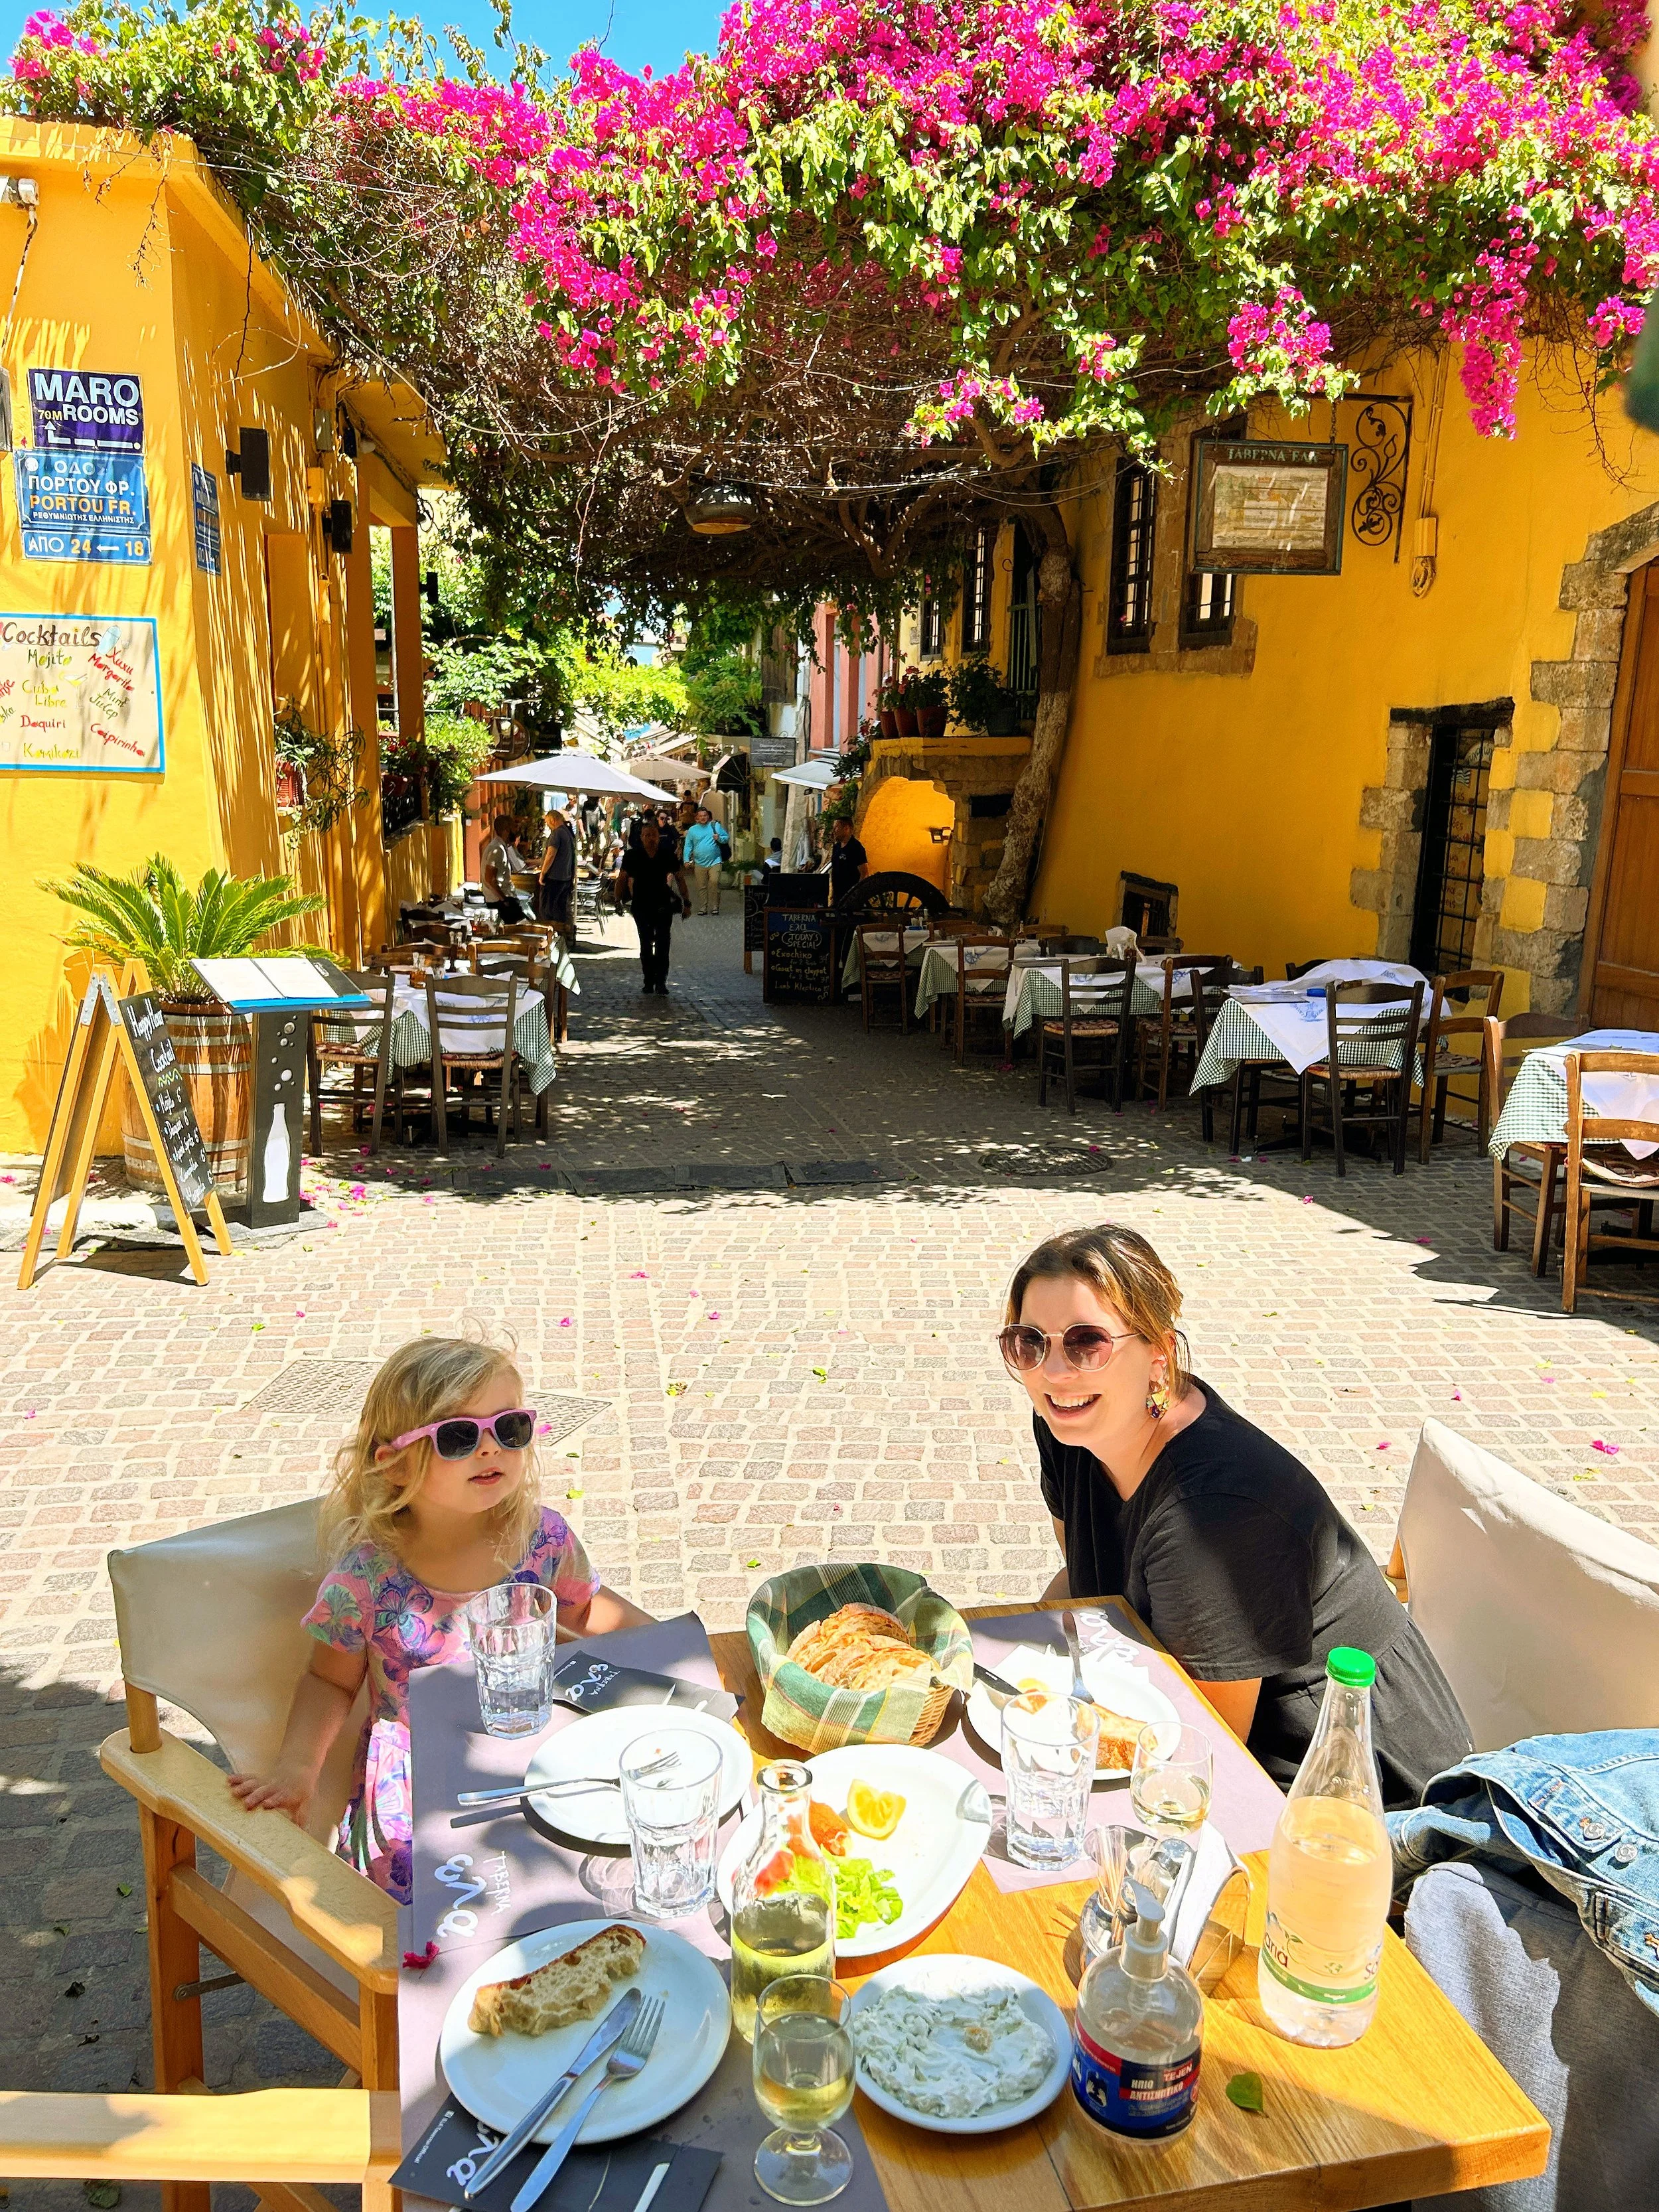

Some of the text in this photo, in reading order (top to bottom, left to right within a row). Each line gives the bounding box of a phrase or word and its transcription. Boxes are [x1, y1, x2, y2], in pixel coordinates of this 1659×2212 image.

[34, 373, 139, 407] MARO
[62, 404, 139, 425] ROOMS
[29, 475, 135, 496] ΠΟΡΤΟΥ ΦΡ.
[30, 495, 136, 515] PORTOU FR.
[29, 536, 144, 556] ΑΠΟ 24 18
[2, 621, 103, 646] Cocktails
[28, 648, 72, 669] Mojito
[23, 680, 59, 695] Cuba
[35, 695, 67, 707] Libre
[787, 938, 818, 950] SPECIAL
[483, 1851, 512, 1915] TABERNA
